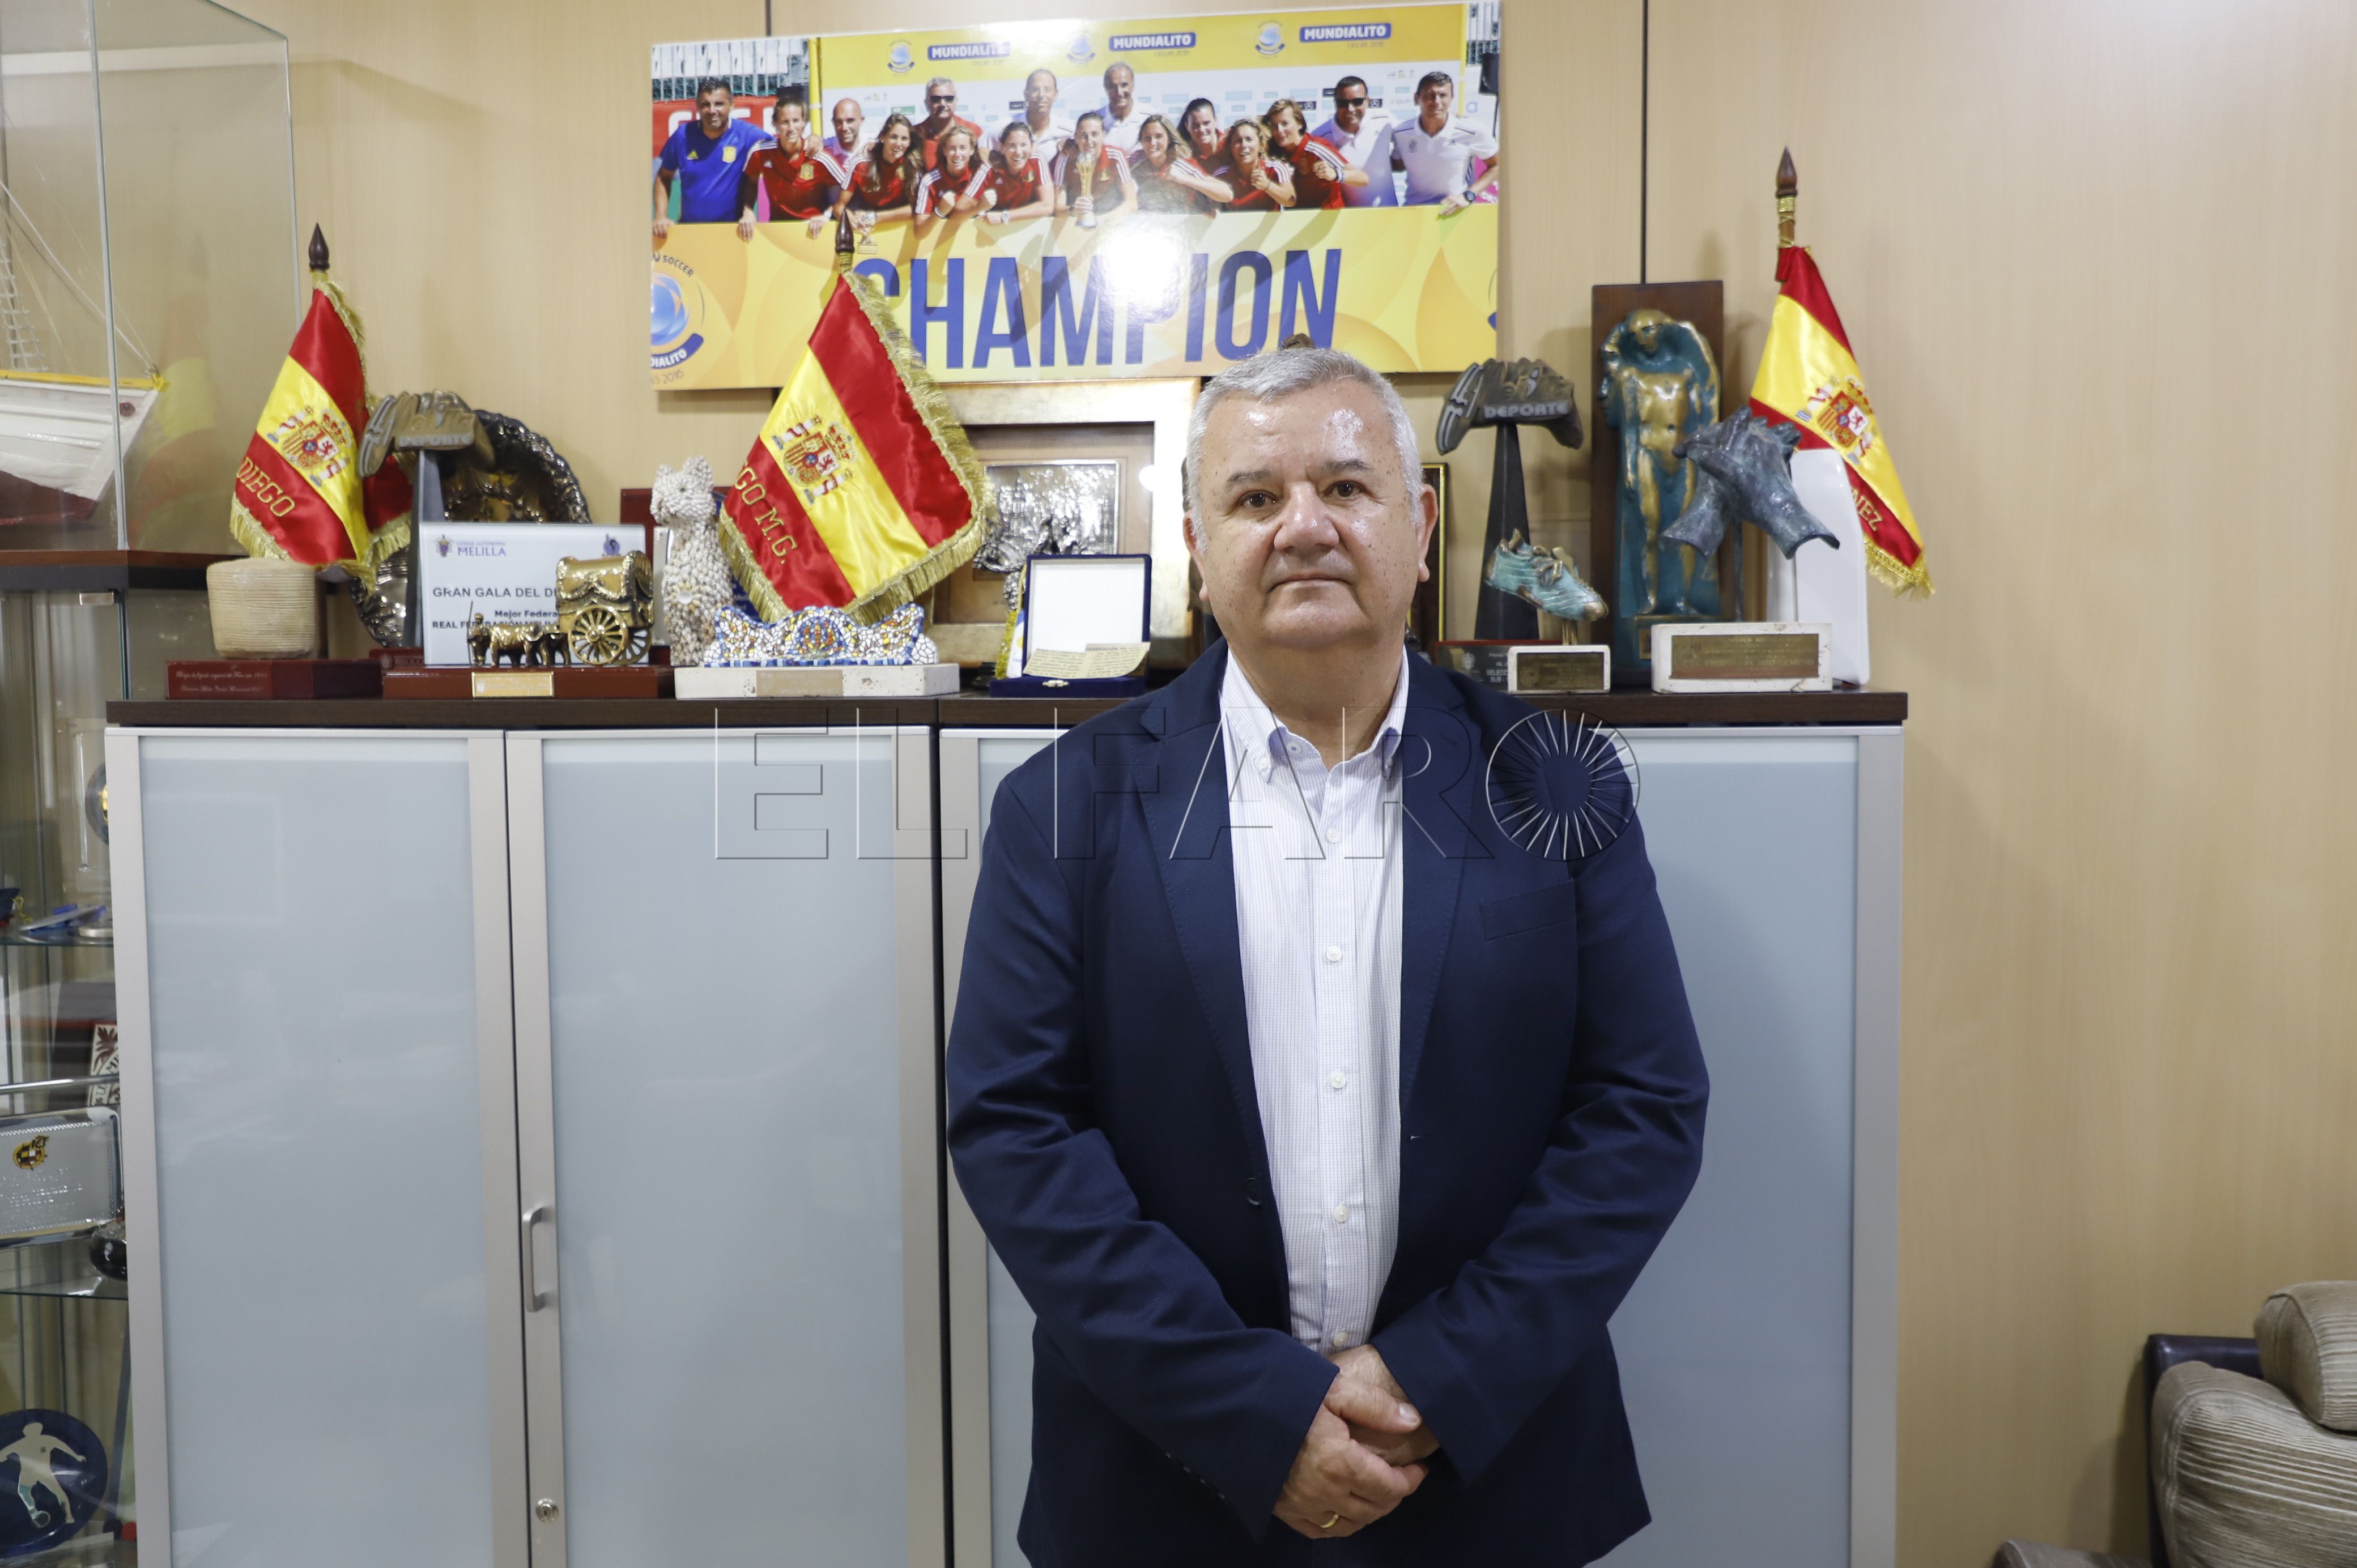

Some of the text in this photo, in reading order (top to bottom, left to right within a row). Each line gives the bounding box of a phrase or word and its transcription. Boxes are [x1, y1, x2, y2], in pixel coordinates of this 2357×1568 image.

[1304, 25, 1386, 40] MUNDIALITO
[1113, 34, 1192, 49] MUNDIALITO
[662, 255, 694, 278] SOCCER
[236, 456, 295, 517] DIEGO
[734, 461, 767, 506] GO
[458, 547, 507, 556] MELILLA
[432, 587, 471, 598] GRAN
[475, 587, 511, 598] GALA
[515, 588, 541, 598] DEL
[495, 611, 522, 621] Mejor
